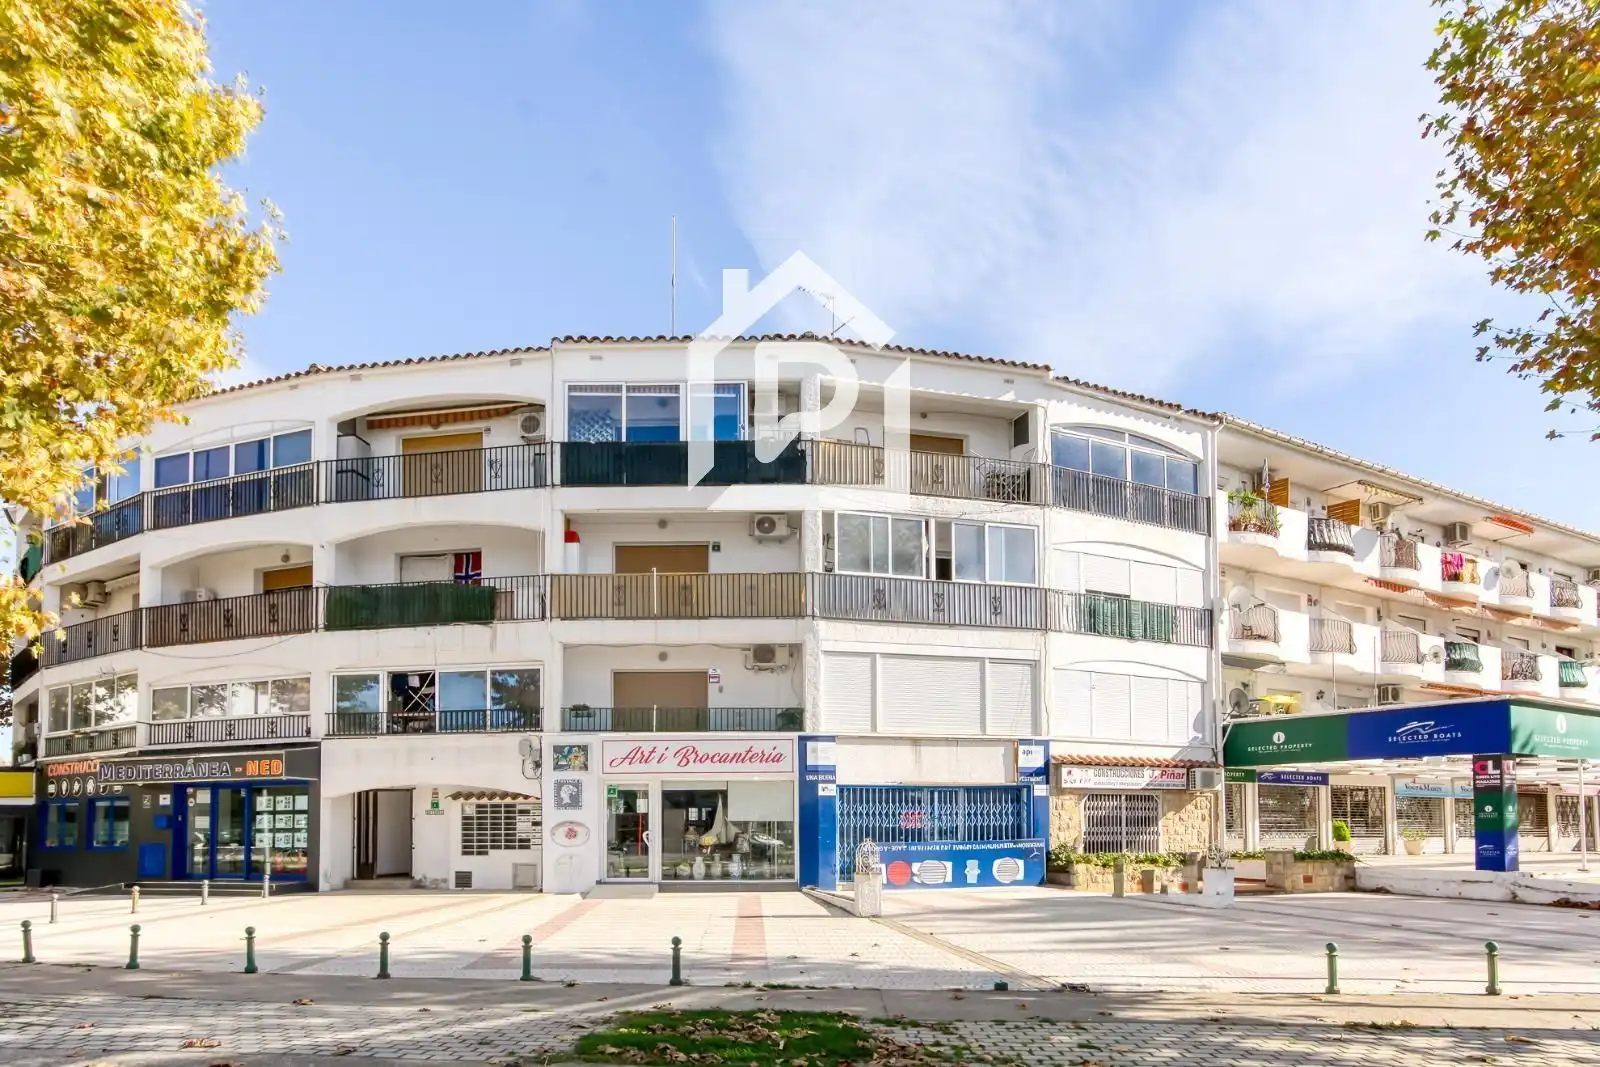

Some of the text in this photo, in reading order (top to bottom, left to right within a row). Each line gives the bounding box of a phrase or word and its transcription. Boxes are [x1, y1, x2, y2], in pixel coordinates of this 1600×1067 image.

[673, 745, 787, 768] Brocanteria
[99, 759, 232, 782] MEDITERRÁNEA
[245, 759, 284, 776] NED
[1093, 768, 1145, 779] CONSTRUCCIONES
[1160, 769, 1186, 780] Piñar
